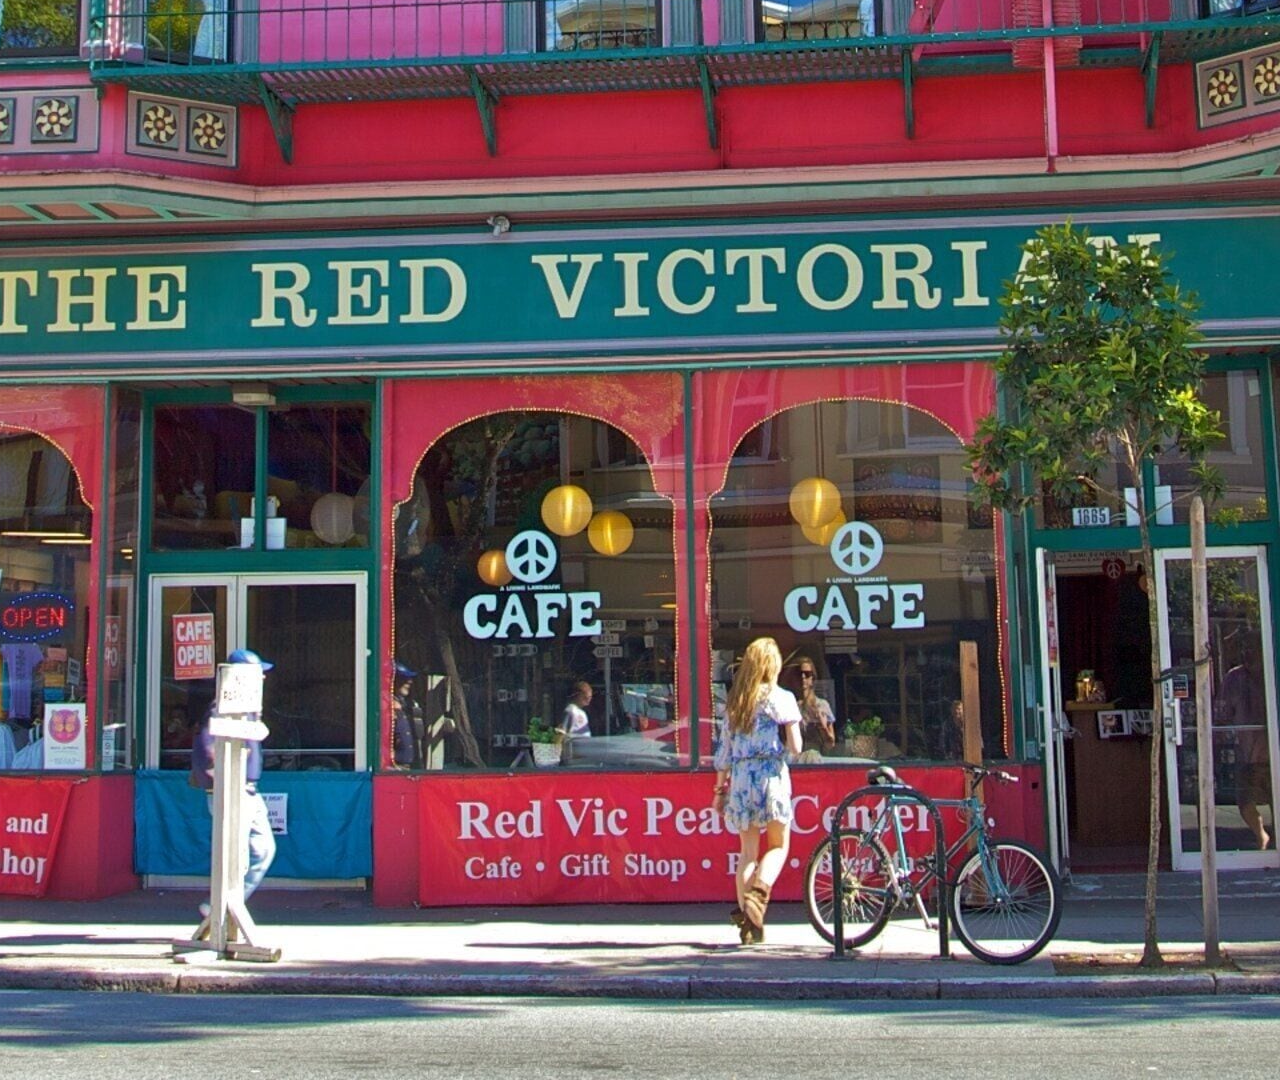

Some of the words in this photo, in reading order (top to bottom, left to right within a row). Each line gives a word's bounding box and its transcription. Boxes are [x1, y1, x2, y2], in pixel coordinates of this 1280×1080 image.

[251, 258, 468, 328] RED
[1076, 508, 1106, 525] 1665
[2, 607, 65, 629] OPEN
[463, 591, 602, 640] CAFE
[783, 583, 925, 632] CAFE
[176, 622, 212, 642] CAFE
[177, 644, 213, 666] OPEN
[6, 813, 48, 834] and
[457, 799, 544, 840] Red
[556, 797, 628, 837] Vic
[464, 855, 522, 880] Cafe
[560, 854, 611, 877] Gift
[624, 852, 687, 882] Shop
